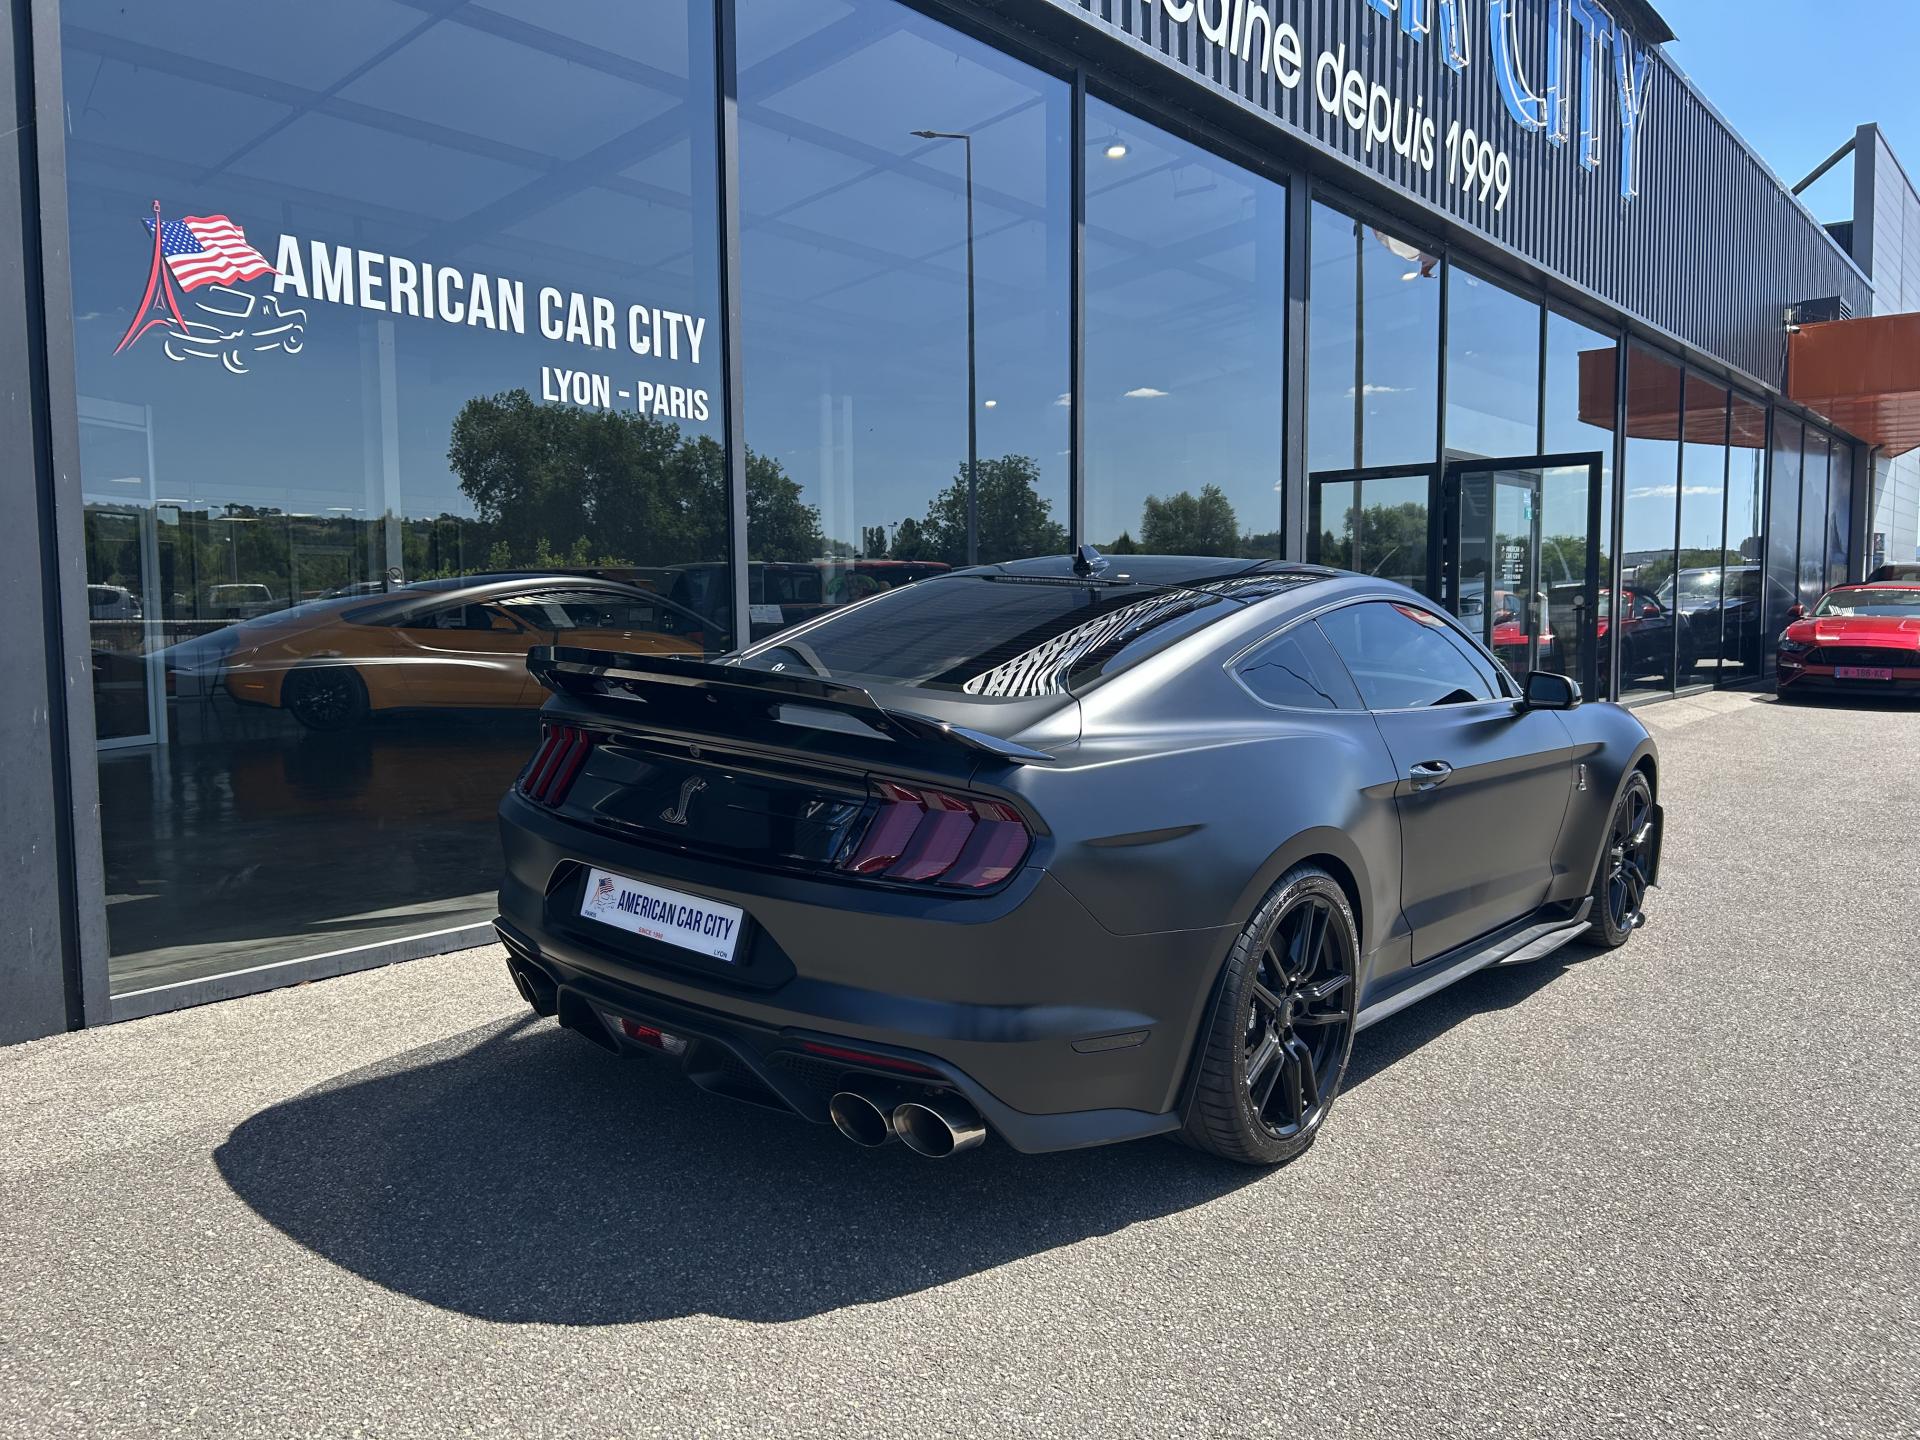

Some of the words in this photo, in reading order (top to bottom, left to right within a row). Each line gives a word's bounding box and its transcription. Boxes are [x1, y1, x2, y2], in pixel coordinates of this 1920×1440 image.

[1315, 42, 1435, 172] depuis
[1445, 120, 1512, 212] 1999
[273, 233, 525, 335] AMERICAN
[539, 286, 617, 350] CAR
[628, 304, 706, 364] CITY
[541, 366, 611, 409] LYON
[637, 380, 709, 422] PARIS
[616, 889, 678, 926] AMERICAN
[676, 905, 704, 933] CAR
[703, 913, 734, 941] CITY
[713, 949, 728, 959] LYON
